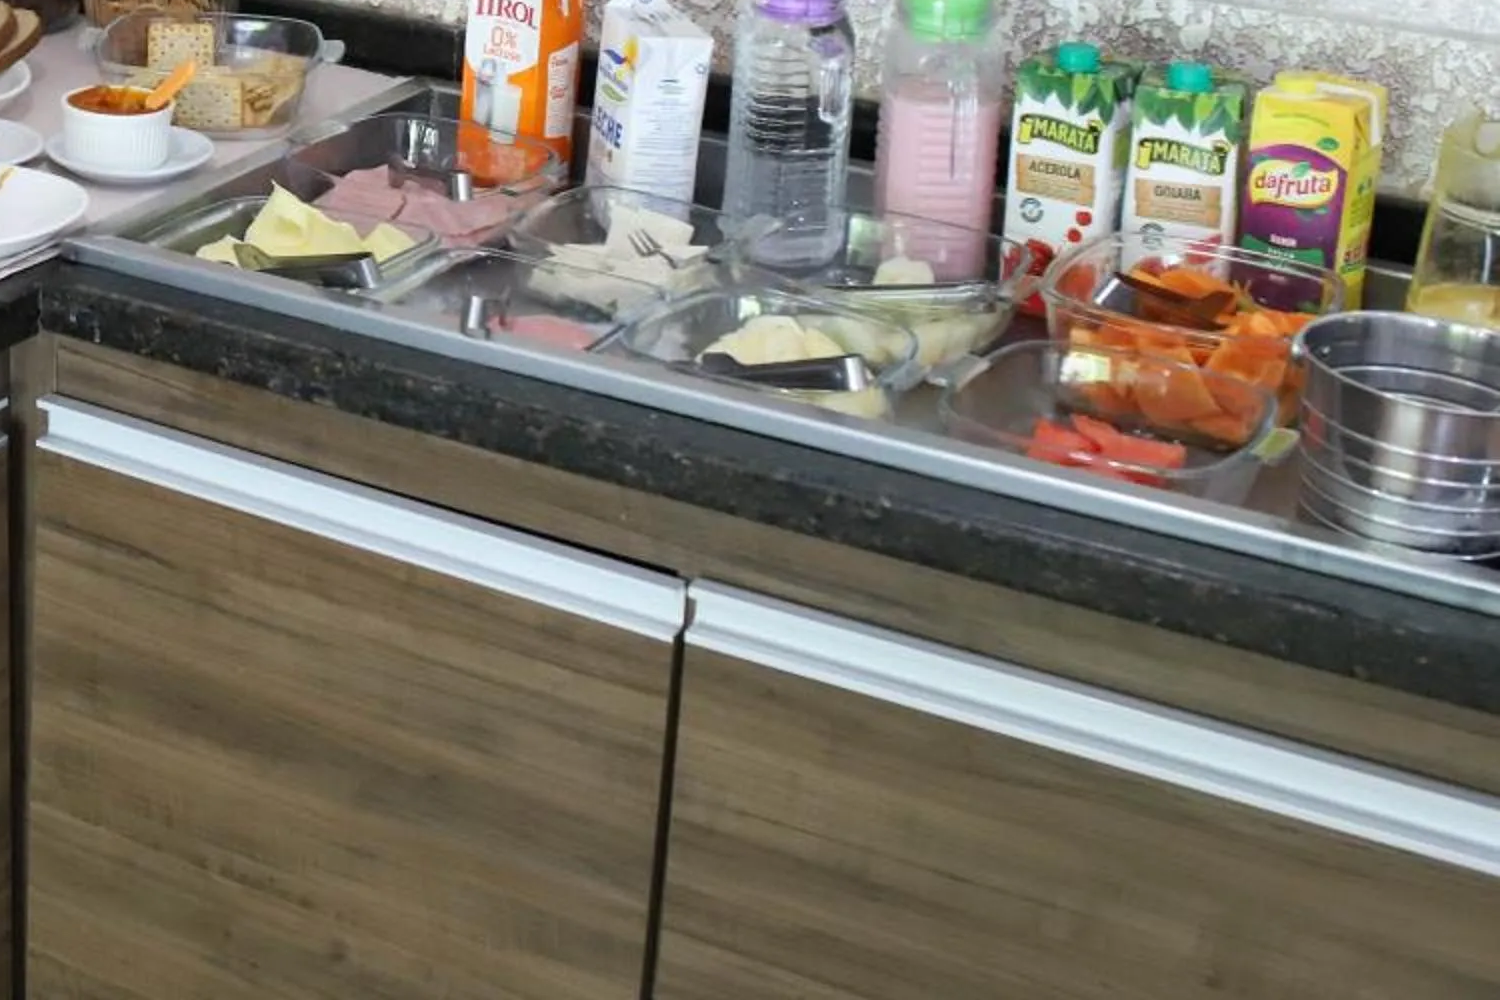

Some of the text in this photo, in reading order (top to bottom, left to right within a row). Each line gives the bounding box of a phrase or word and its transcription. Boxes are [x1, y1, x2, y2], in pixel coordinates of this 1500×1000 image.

[594, 104, 623, 149] ECHE
[1028, 160, 1081, 179] ACEROLA
[1254, 171, 1332, 198] dafruta
